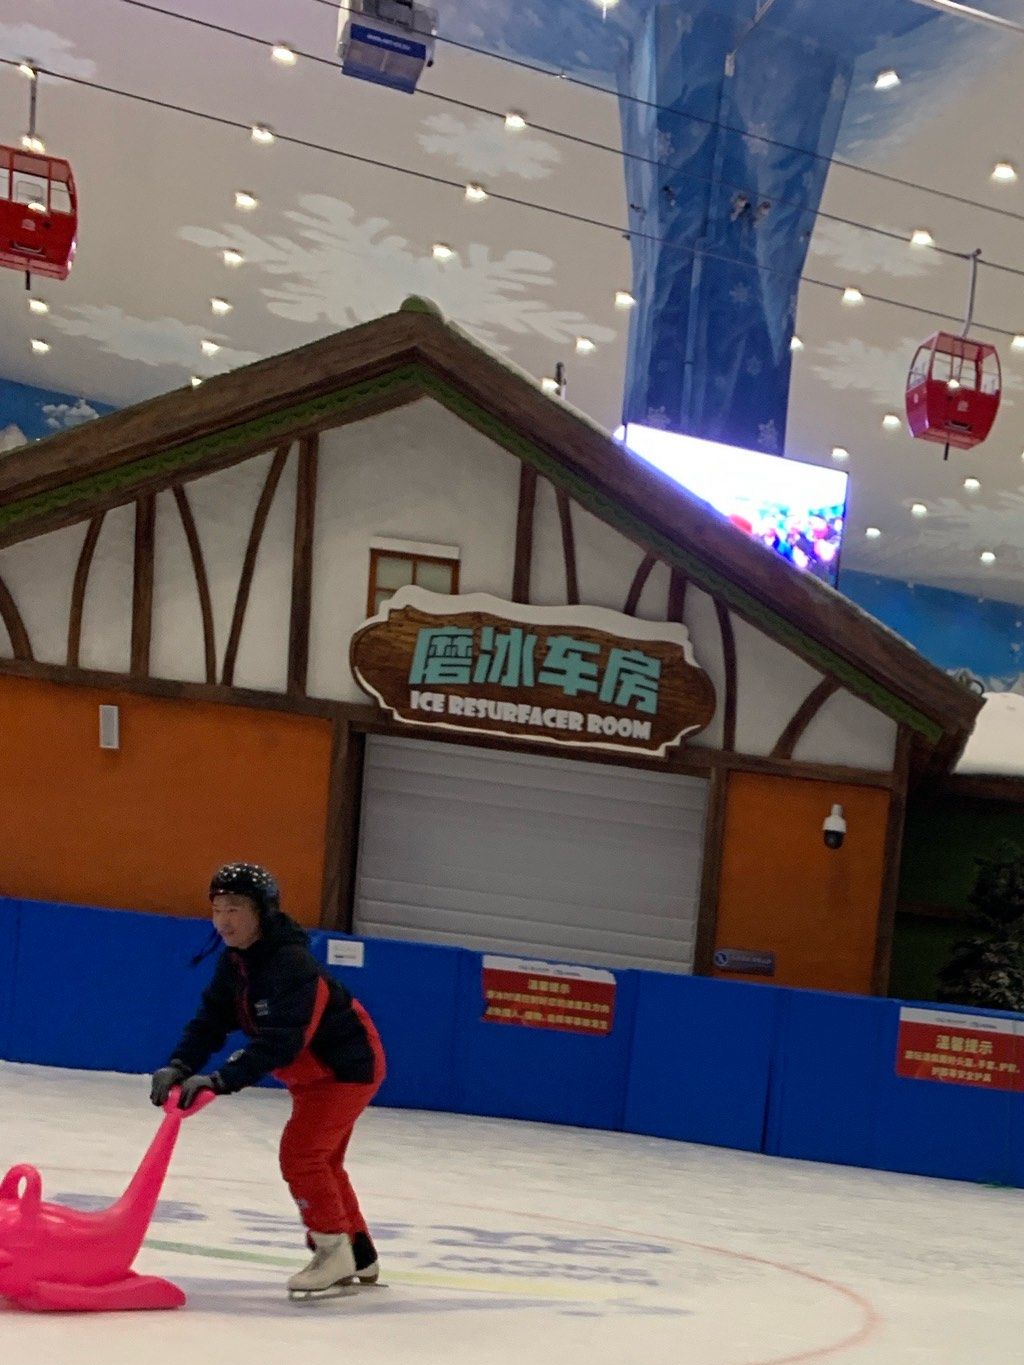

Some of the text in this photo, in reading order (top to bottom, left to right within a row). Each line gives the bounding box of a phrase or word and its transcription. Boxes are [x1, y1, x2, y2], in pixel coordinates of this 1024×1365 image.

[408, 626, 661, 714] 磨冰车房
[410, 690, 652, 739] ICE RESURFACER ROOM
